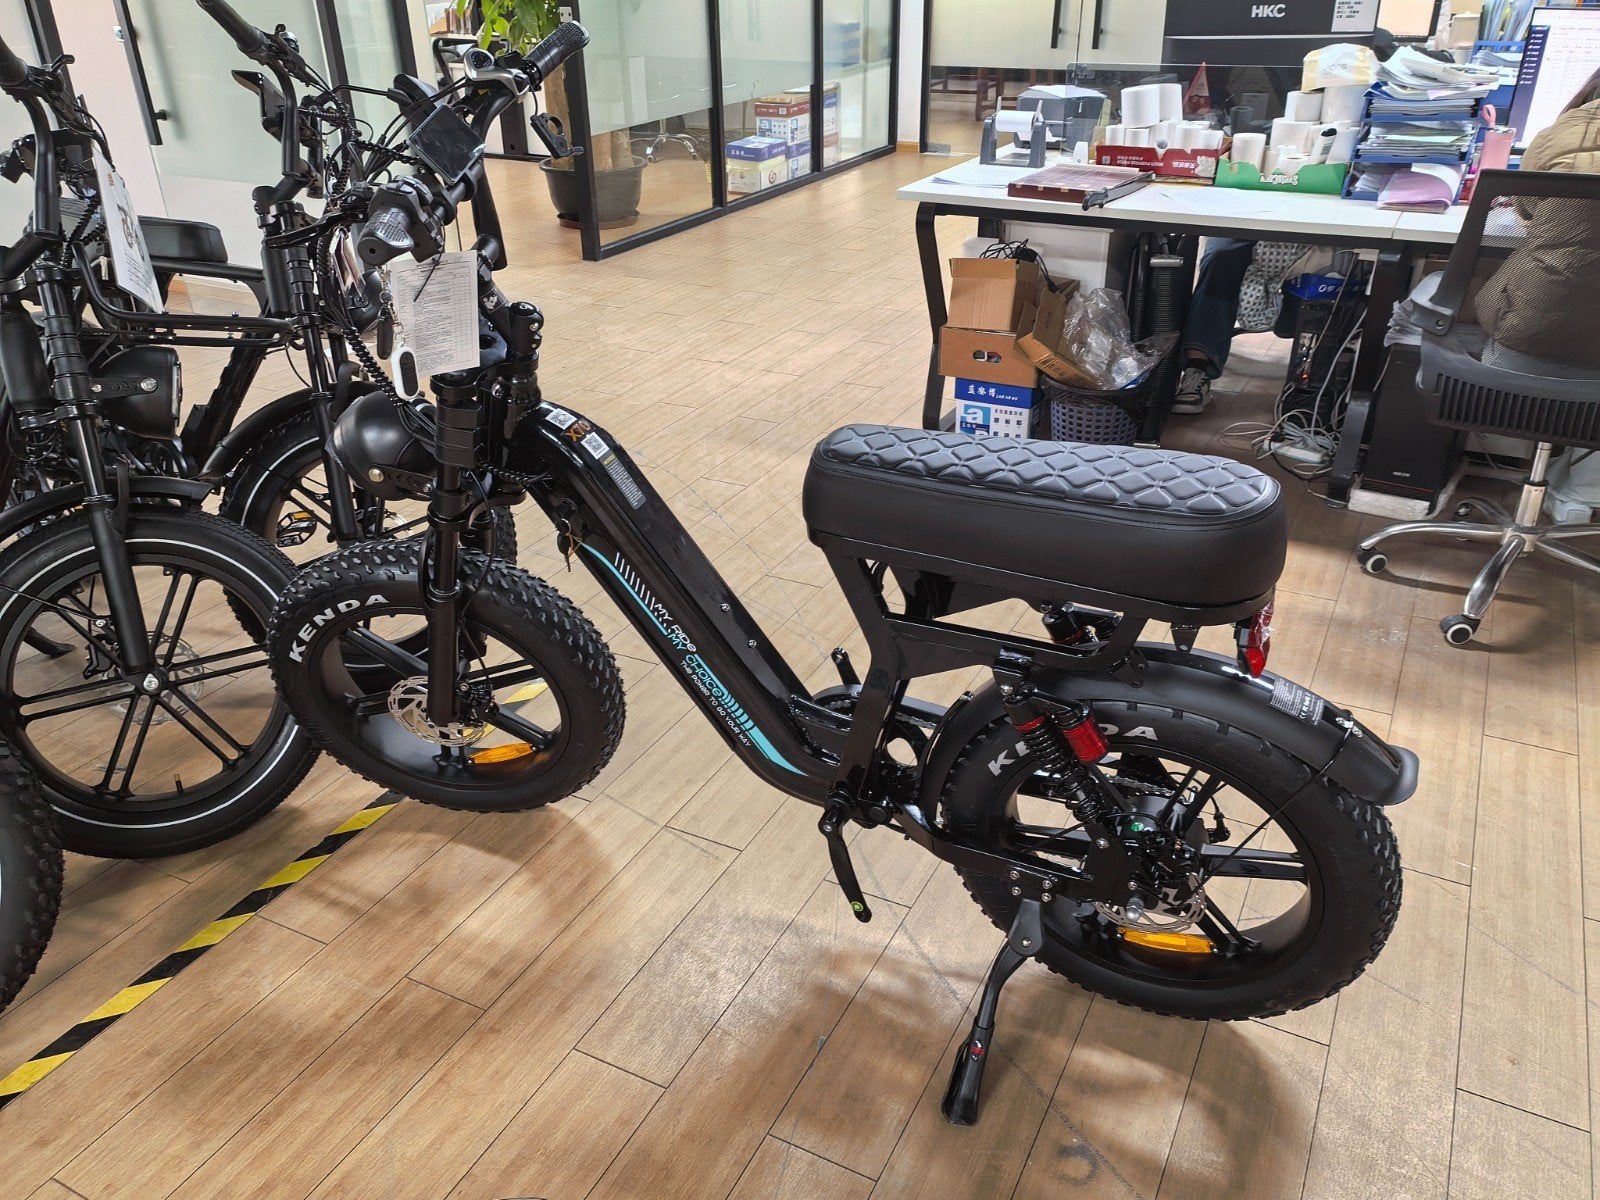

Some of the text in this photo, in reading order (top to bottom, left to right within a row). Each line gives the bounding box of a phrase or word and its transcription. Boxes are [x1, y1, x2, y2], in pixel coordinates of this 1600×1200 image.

[1251, 4, 1286, 18] HKC
[565, 420, 592, 442] X70
[654, 603, 673, 621] MY
[289, 594, 389, 663] KENDA
[668, 633, 687, 650] MY
[725, 716, 741, 734] YOUR
[739, 733, 751, 747] WAY
[987, 723, 1158, 777] KDA
